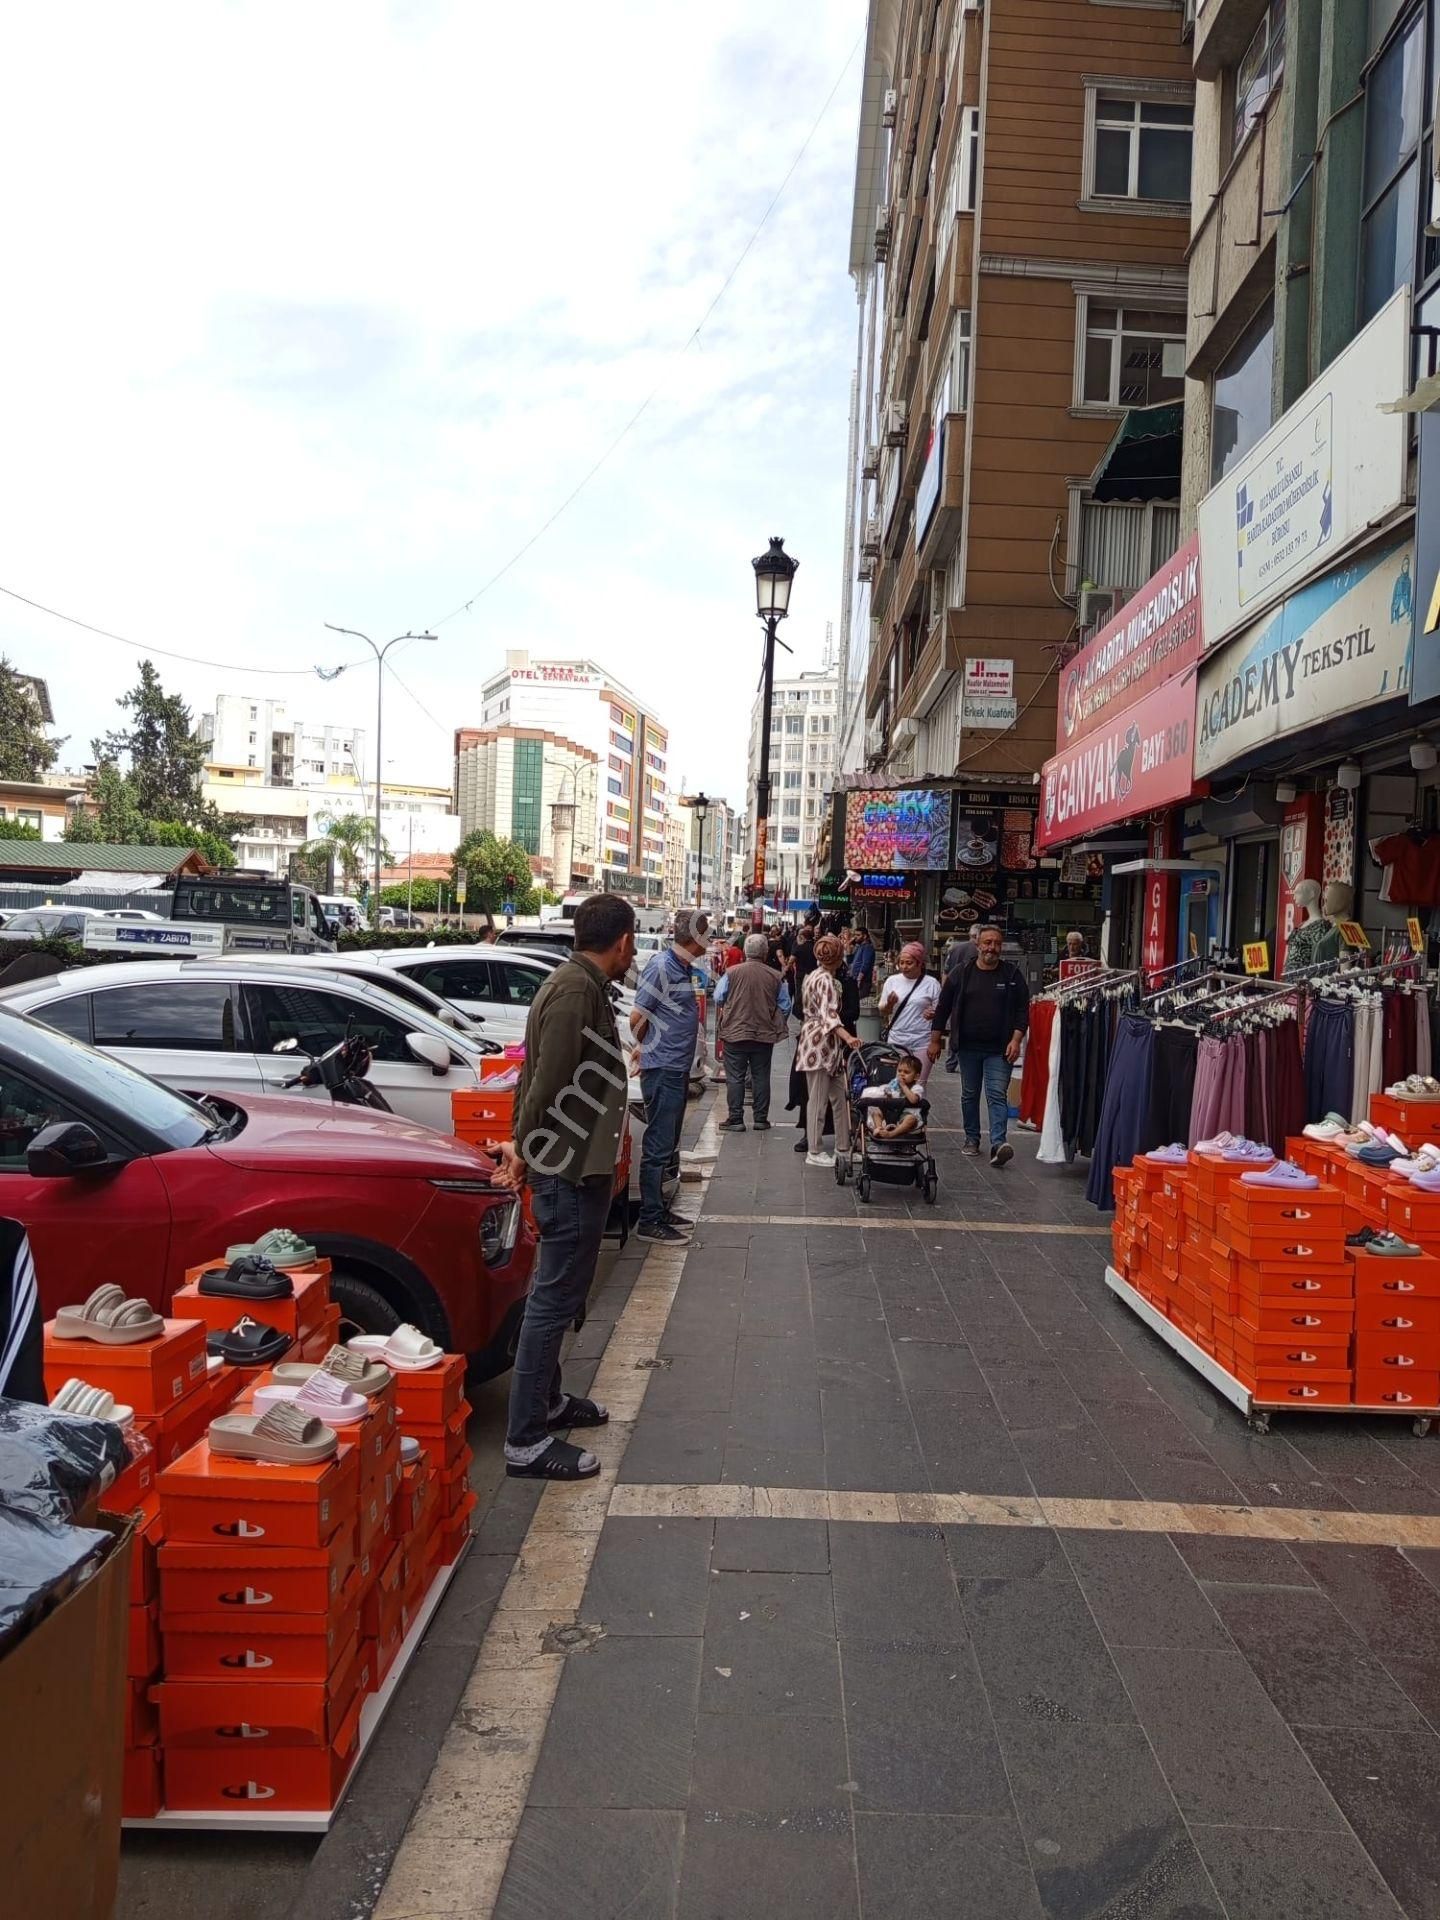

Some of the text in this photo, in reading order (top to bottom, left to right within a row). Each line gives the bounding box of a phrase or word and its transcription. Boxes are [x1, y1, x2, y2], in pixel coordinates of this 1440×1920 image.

[1126, 552, 1200, 660] MÜHENDİSLİK
[512, 669, 539, 680] OTEL
[1200, 624, 1376, 745] ACADEMY TEKSTİL
[964, 706, 985, 718] Erkek
[1057, 732, 1120, 824] GANYAN
[863, 874, 905, 887] ERSOY
